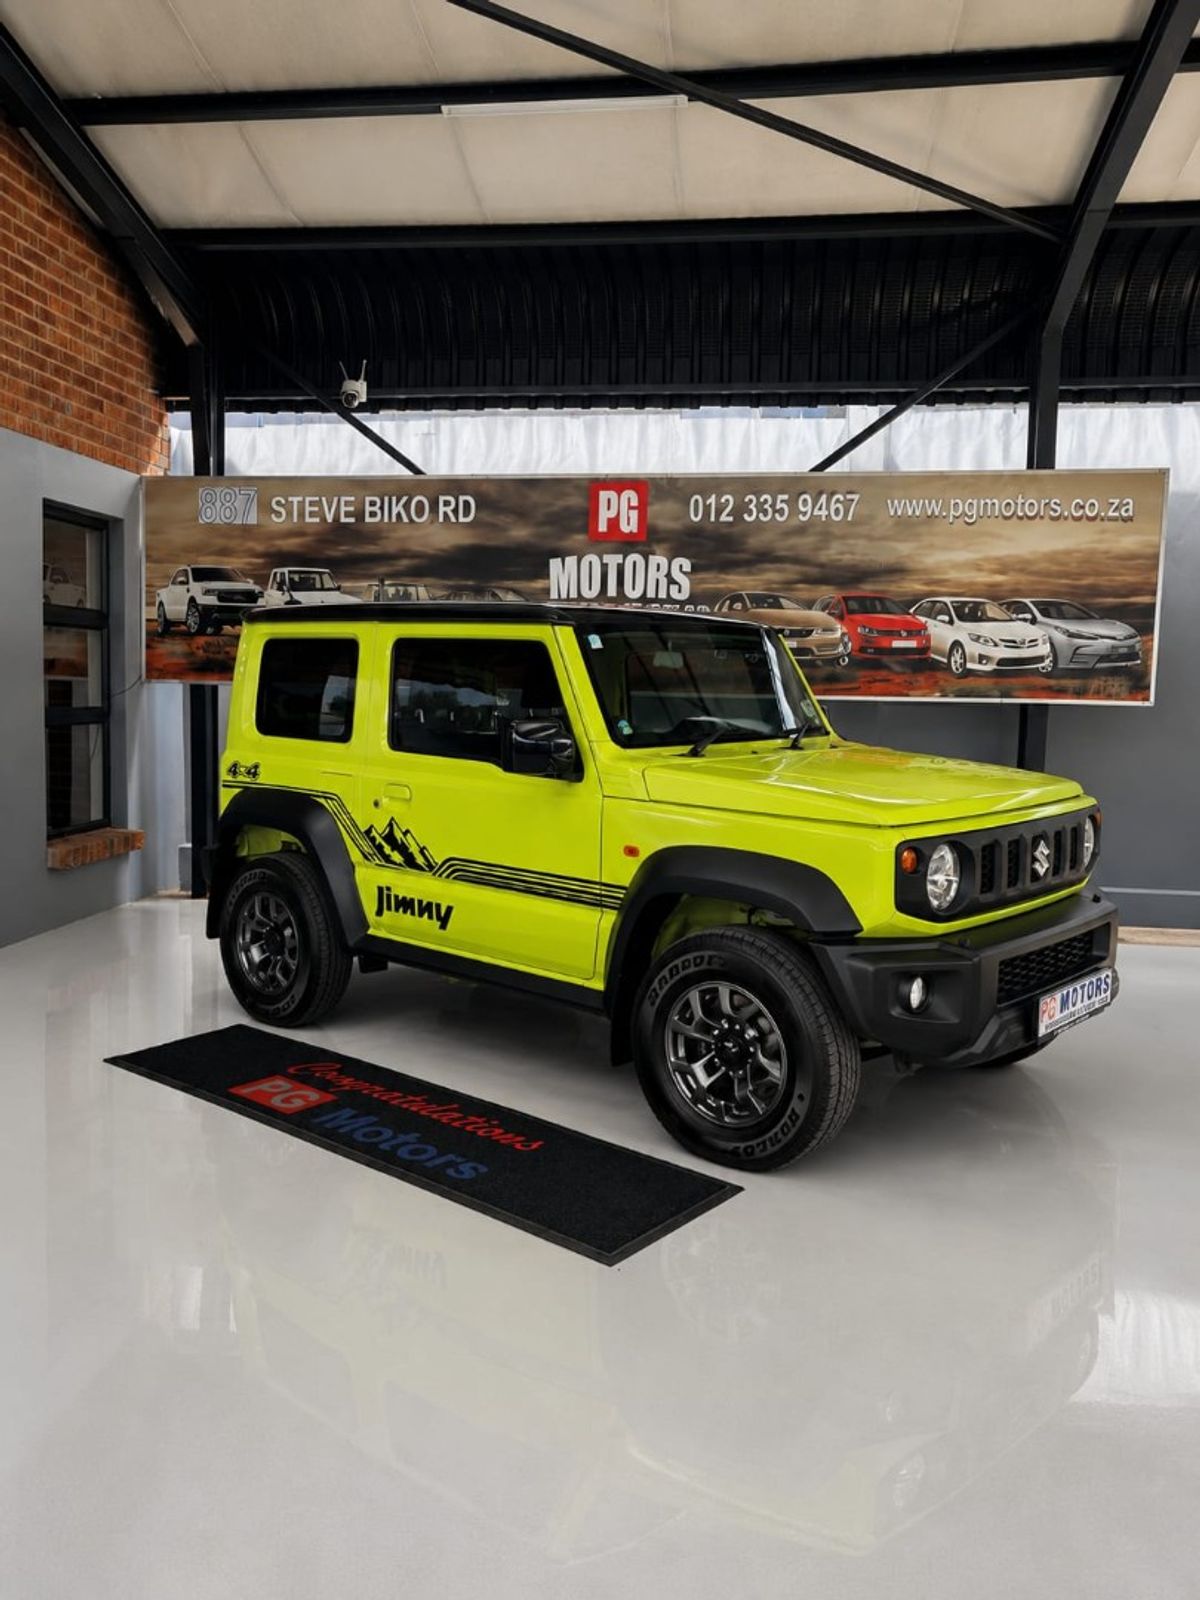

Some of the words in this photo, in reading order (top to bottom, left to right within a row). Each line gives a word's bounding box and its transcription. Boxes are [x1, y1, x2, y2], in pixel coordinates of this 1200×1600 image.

[199, 487, 257, 525] 887
[271, 496, 356, 523] STEVE
[364, 495, 430, 523] BIKO
[438, 494, 476, 523] RD
[598, 489, 639, 534] PG
[689, 493, 734, 522] 012
[743, 494, 789, 522] 335
[798, 493, 860, 522] 9467
[887, 494, 1135, 523] www.pgmotors.co.za
[549, 553, 692, 600] MOTORS
[375, 885, 454, 931] Jimny
[1041, 996, 1056, 1022] PG
[1060, 974, 1109, 1013] MOTORS
[286, 1062, 546, 1151] Congratulations
[243, 1079, 321, 1110] PG
[310, 1106, 489, 1181] Motors
